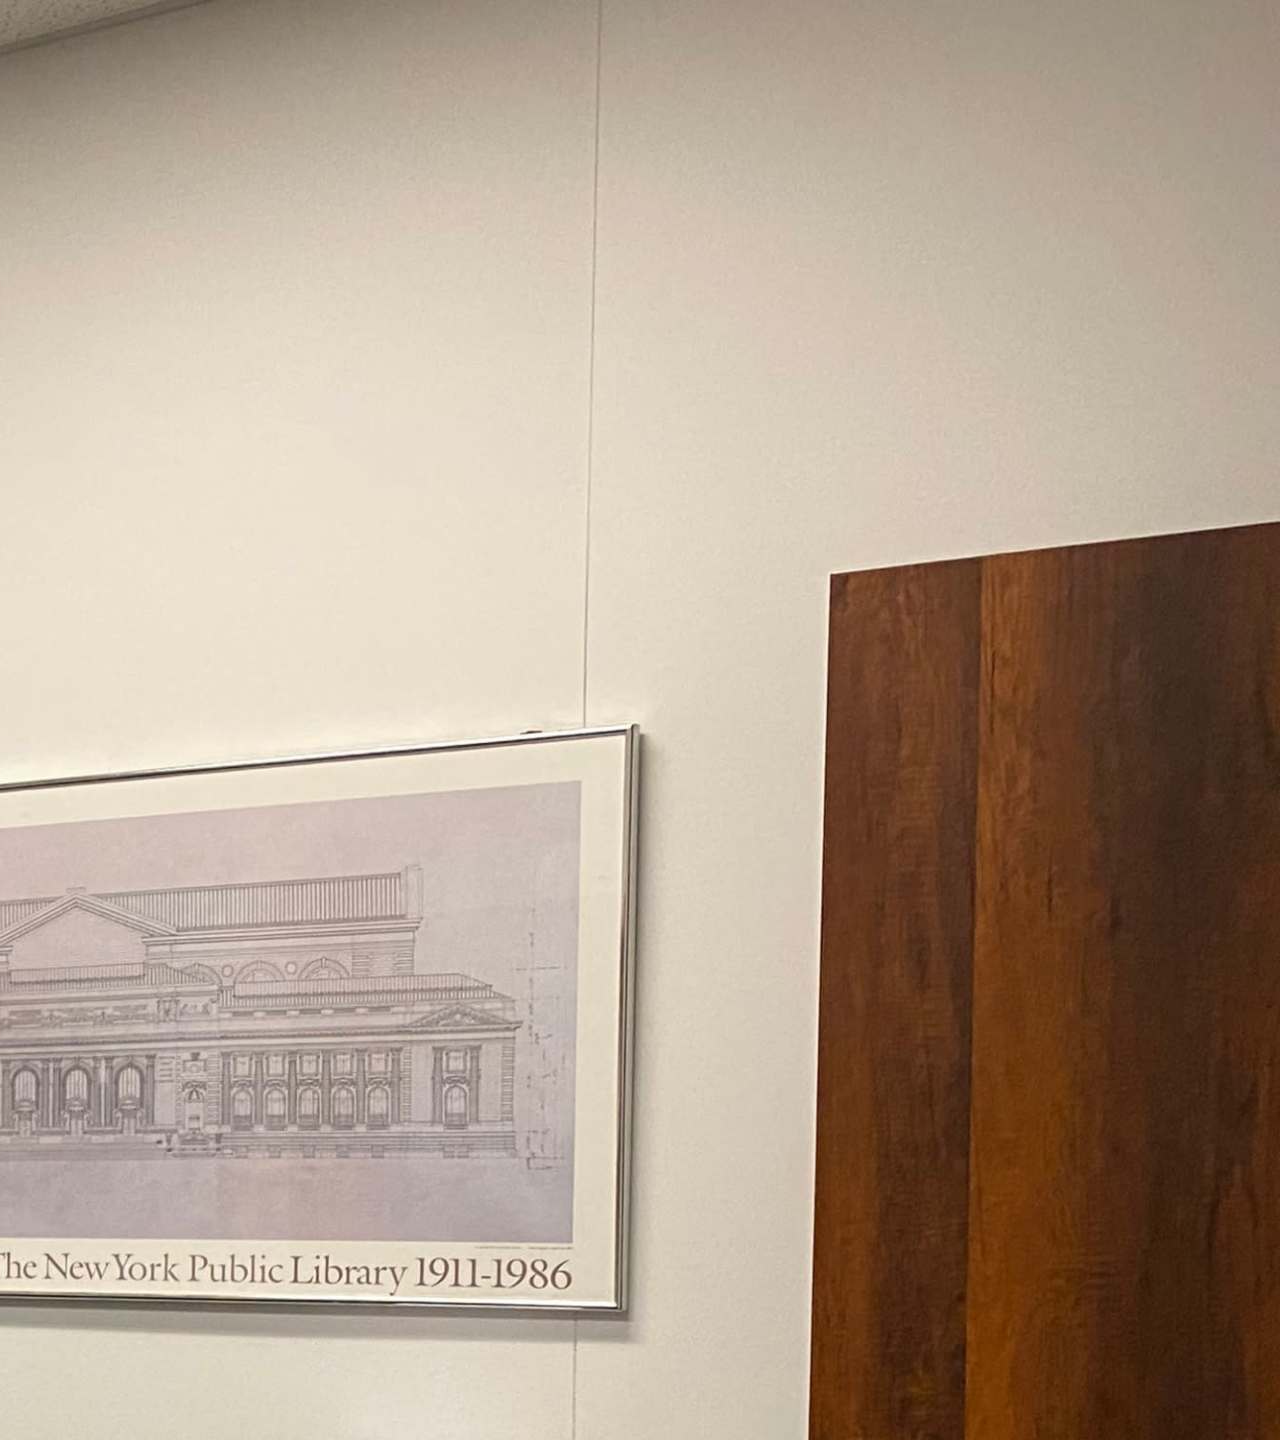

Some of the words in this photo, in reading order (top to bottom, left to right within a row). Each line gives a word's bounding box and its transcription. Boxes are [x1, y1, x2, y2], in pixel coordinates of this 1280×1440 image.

[42, 1252, 112, 1281] New
[111, 1252, 180, 1283] York
[186, 1253, 284, 1284] Public
[289, 1254, 409, 1296] Library
[414, 1256, 574, 1291] 1911-1986
